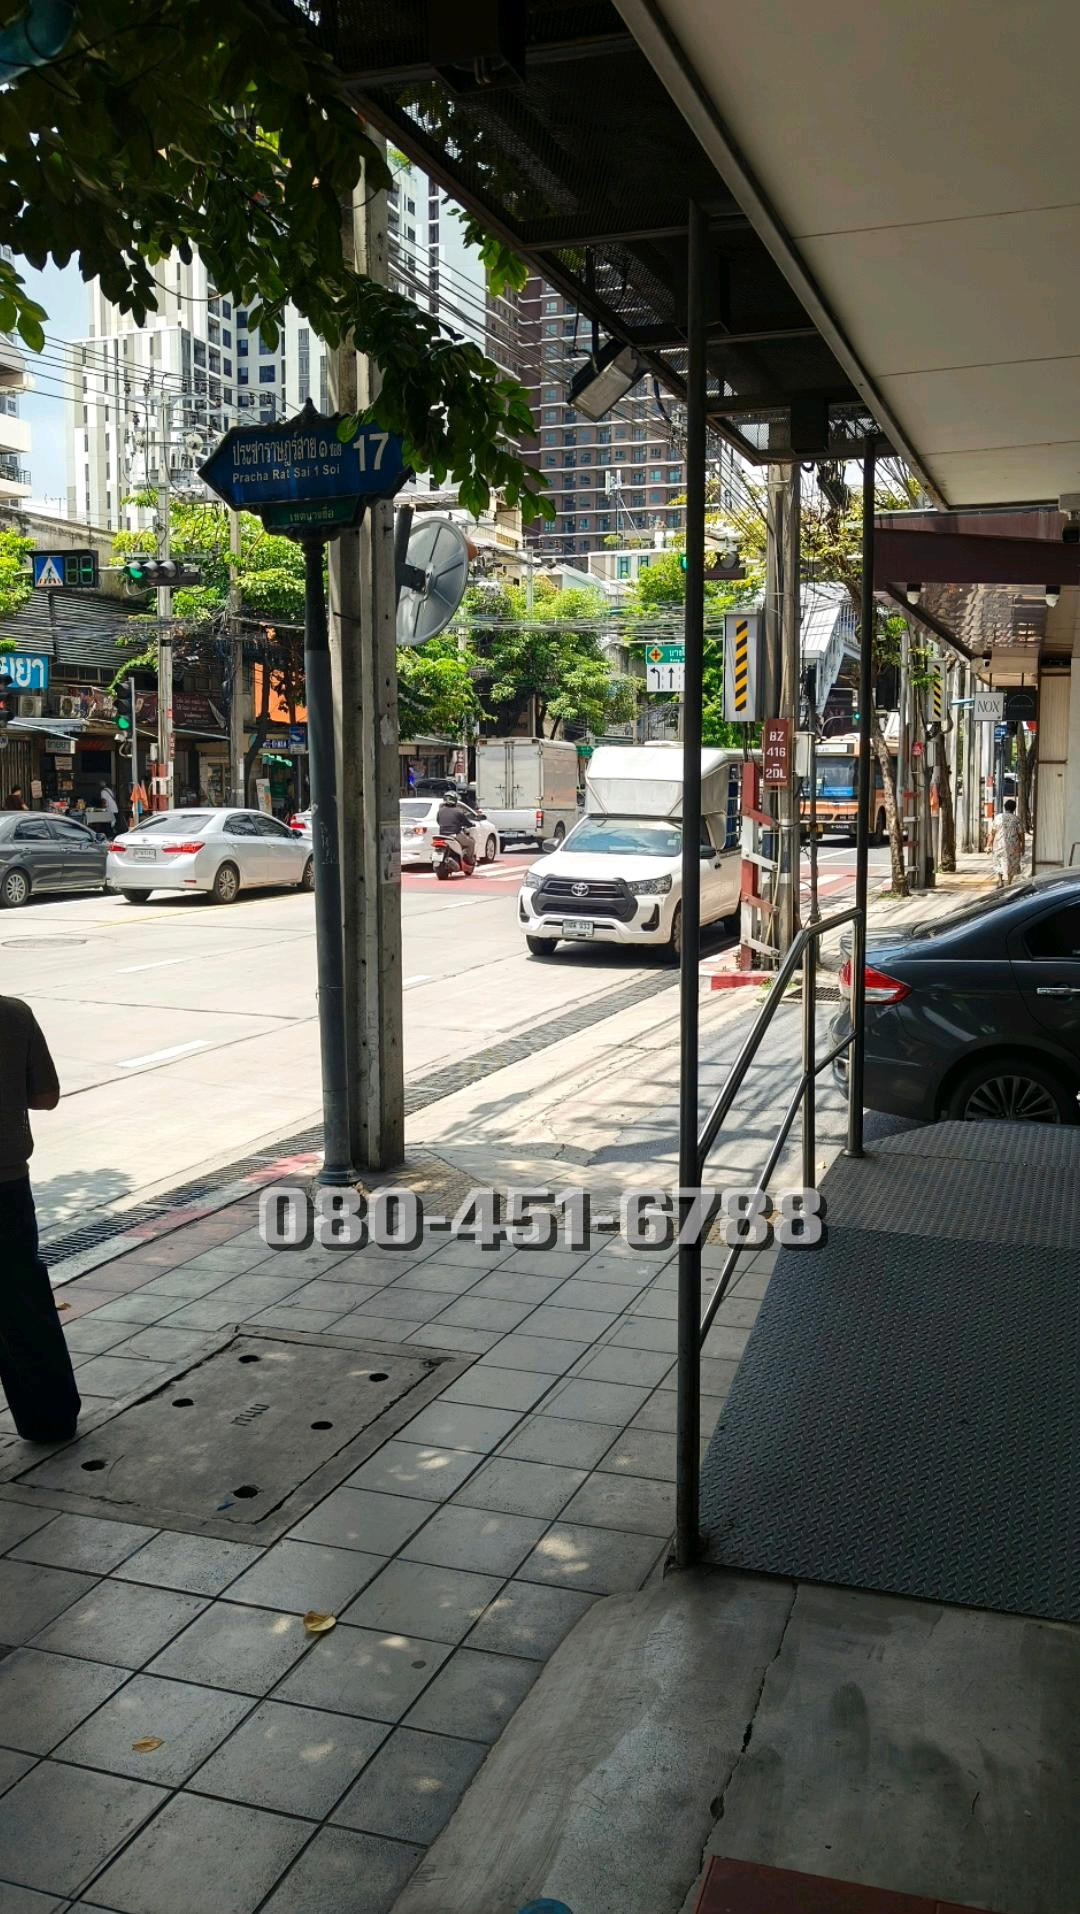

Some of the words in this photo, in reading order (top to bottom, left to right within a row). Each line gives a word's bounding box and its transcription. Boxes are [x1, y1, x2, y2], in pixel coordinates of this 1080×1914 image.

[353, 432, 389, 472] 17
[232, 472, 269, 484] Pracha
[272, 468, 290, 480] Rat
[293, 465, 310, 478] Sai
[314, 465, 319, 476] 1
[322, 463, 340, 475] Soi
[978, 700, 999, 713] NOX
[769, 731, 785, 742] BZ
[766, 747, 786, 757] 416
